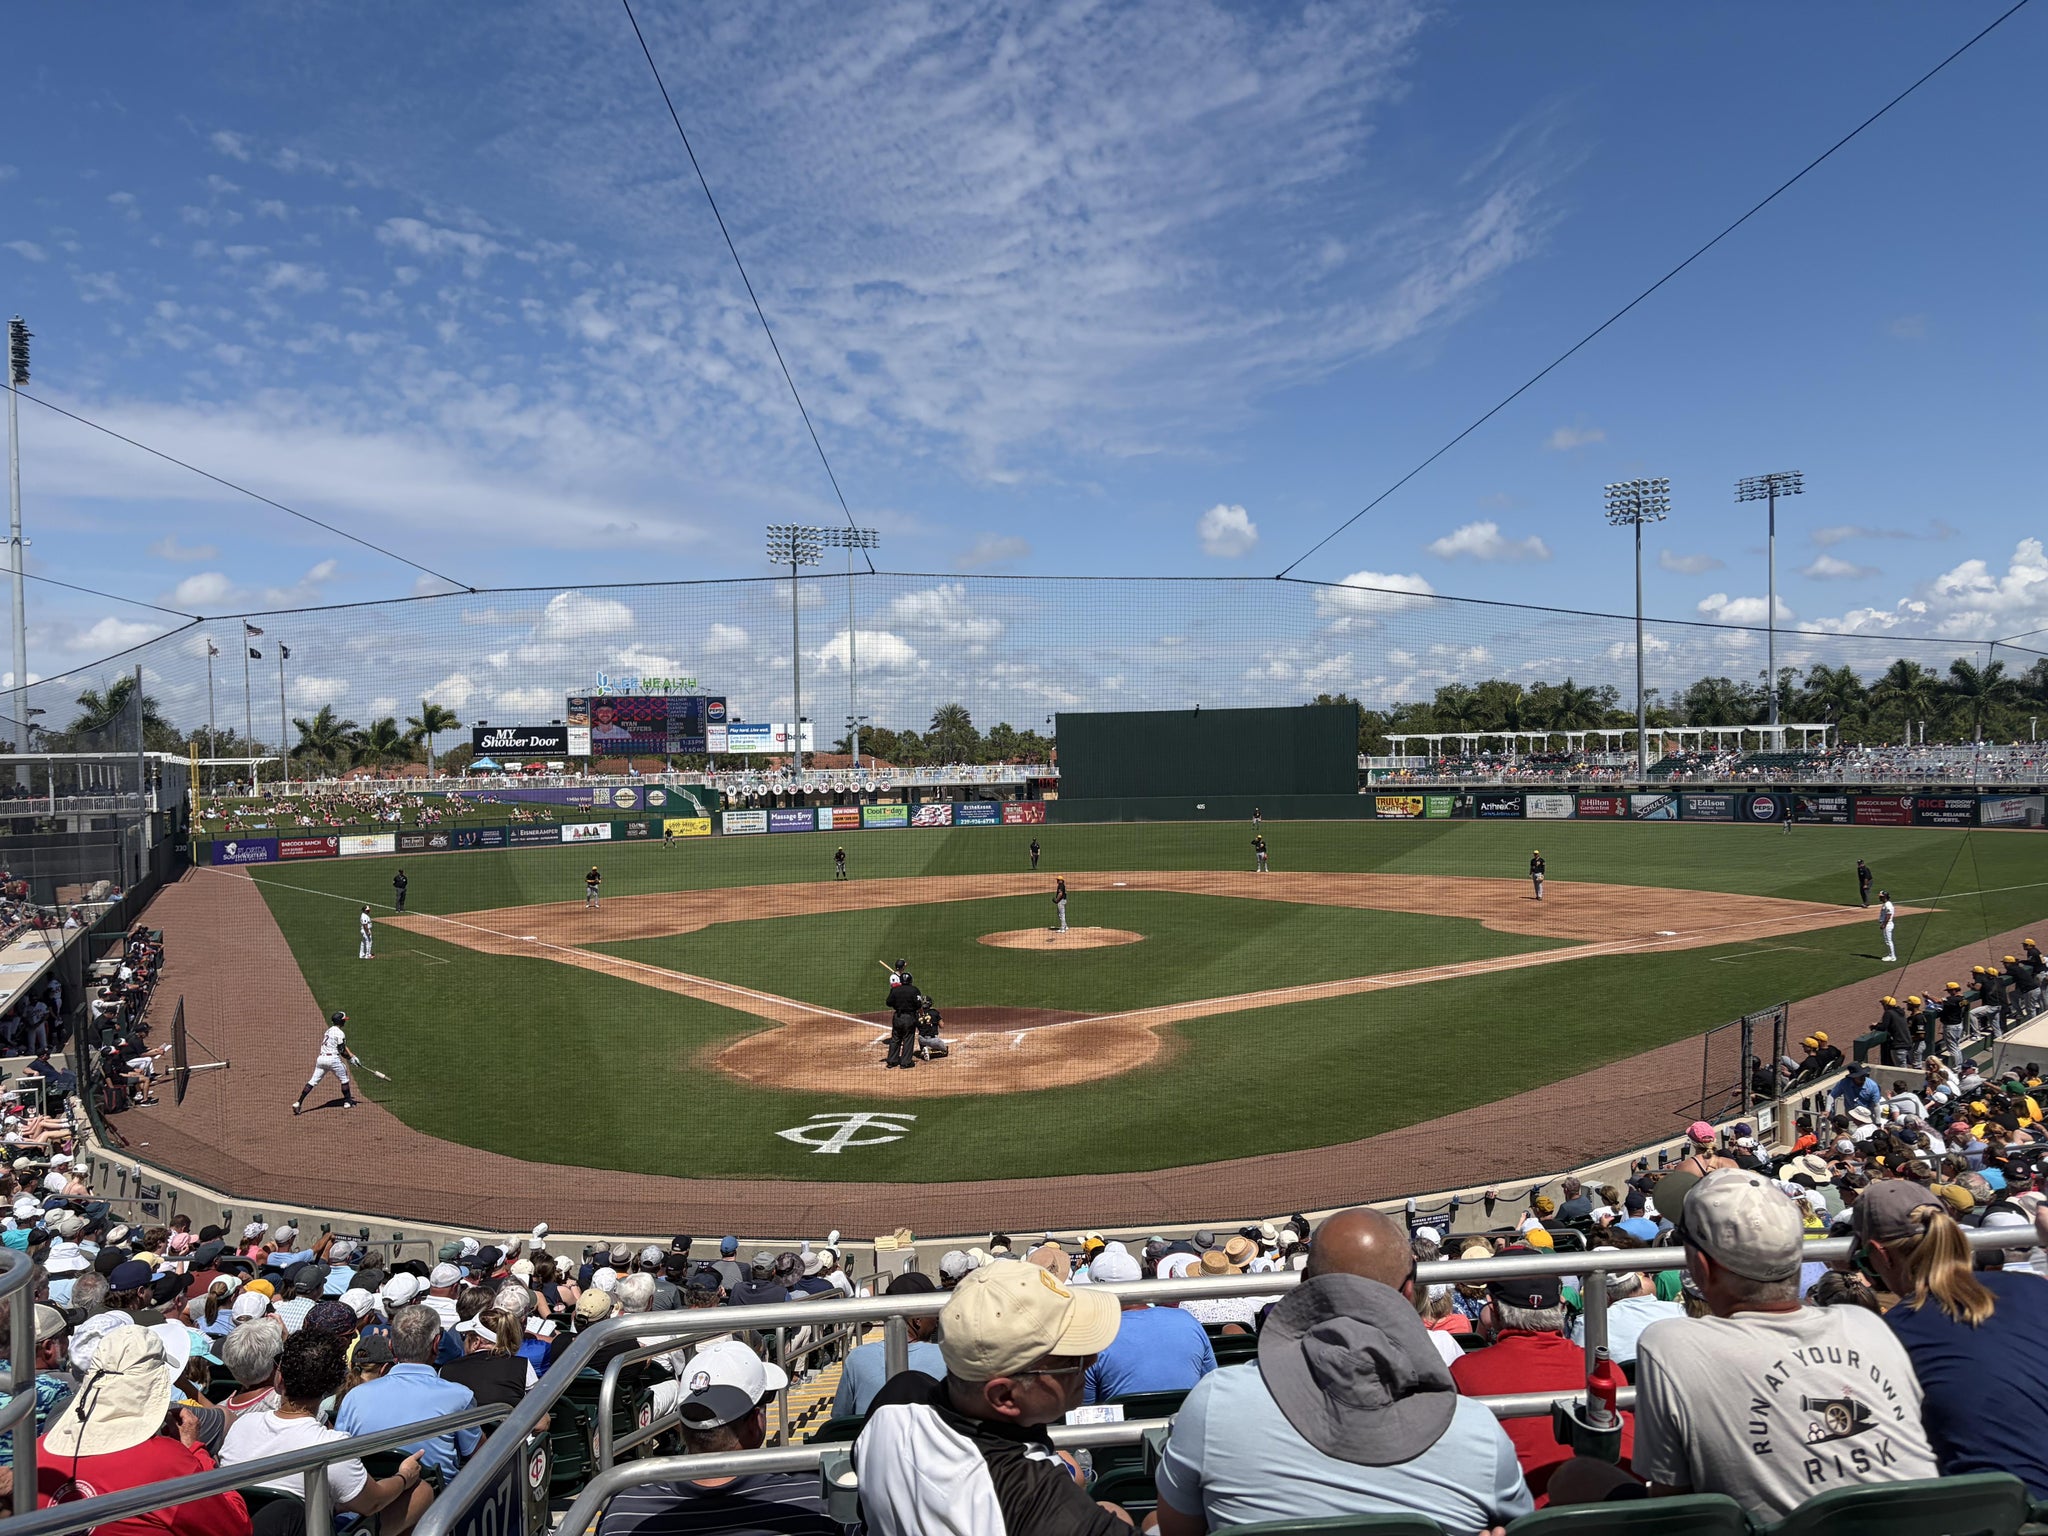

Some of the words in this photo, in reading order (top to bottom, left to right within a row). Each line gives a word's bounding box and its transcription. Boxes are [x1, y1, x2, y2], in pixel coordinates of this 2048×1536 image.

[612, 678, 638, 688] LEE
[643, 678, 697, 688] HEALTH
[496, 729, 516, 740] MY
[481, 735, 528, 748] Shower
[529, 736, 559, 747] Door
[742, 785, 752, 794] 42
[760, 786, 765, 794] 3
[775, 785, 780, 793] 6
[789, 785, 797, 793] 29
[819, 784, 828, 792] 34
[835, 784, 844, 792] 28
[851, 783, 859, 791] 10
[881, 782, 890, 790] 36
[1377, 797, 1400, 806] TRULY
[1697, 799, 1725, 807] Edison
[1918, 800, 1945, 808] RICE
[1637, 795, 1672, 818] SCHULTZ
[771, 813, 797, 822] Massage
[797, 812, 812, 822] Envy
[1749, 1397, 1773, 1455] RUN
[1765, 1360, 1791, 1393] AT
[1792, 1346, 1860, 1369] YOUR
[1870, 1365, 1905, 1421] OWN
[1804, 1438, 1898, 1485] RISK
[467, 1470, 513, 1536] 07
